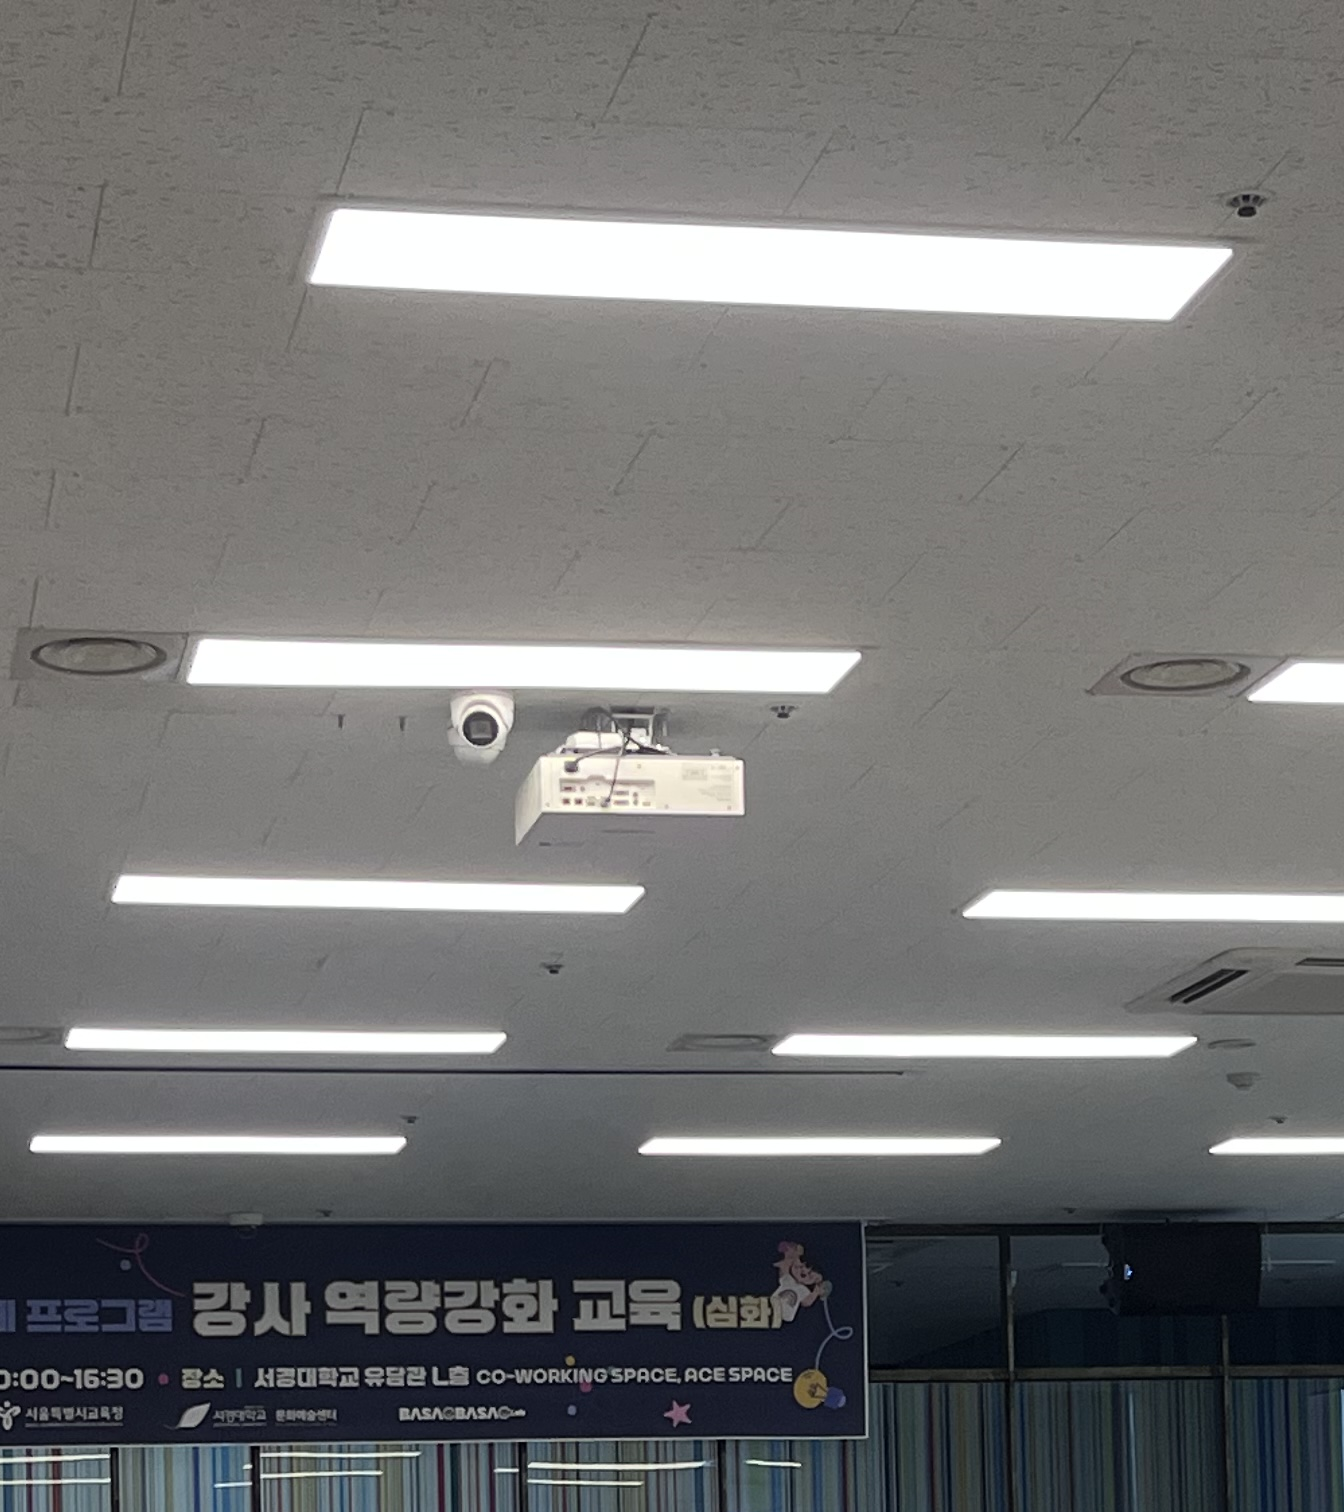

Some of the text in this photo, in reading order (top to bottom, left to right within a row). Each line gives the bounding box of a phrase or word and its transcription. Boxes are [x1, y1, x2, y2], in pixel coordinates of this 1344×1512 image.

[27, 1300, 173, 1333] 프로그램
[194, 1279, 783, 1336] 강사 역량강화 교육 (심화)
[182, 1368, 225, 1389] 장소
[254, 1367, 360, 1388] 서경대학교
[364, 1367, 427, 1387] 유담관
[477, 1367, 608, 1385] CO-WORKING
[610, 1367, 682, 1384] SPACE,
[685, 1367, 726, 1383] ACE
[729, 1367, 793, 1383] SPACE
[25, 1406, 124, 1422] 서울특별시교육청
